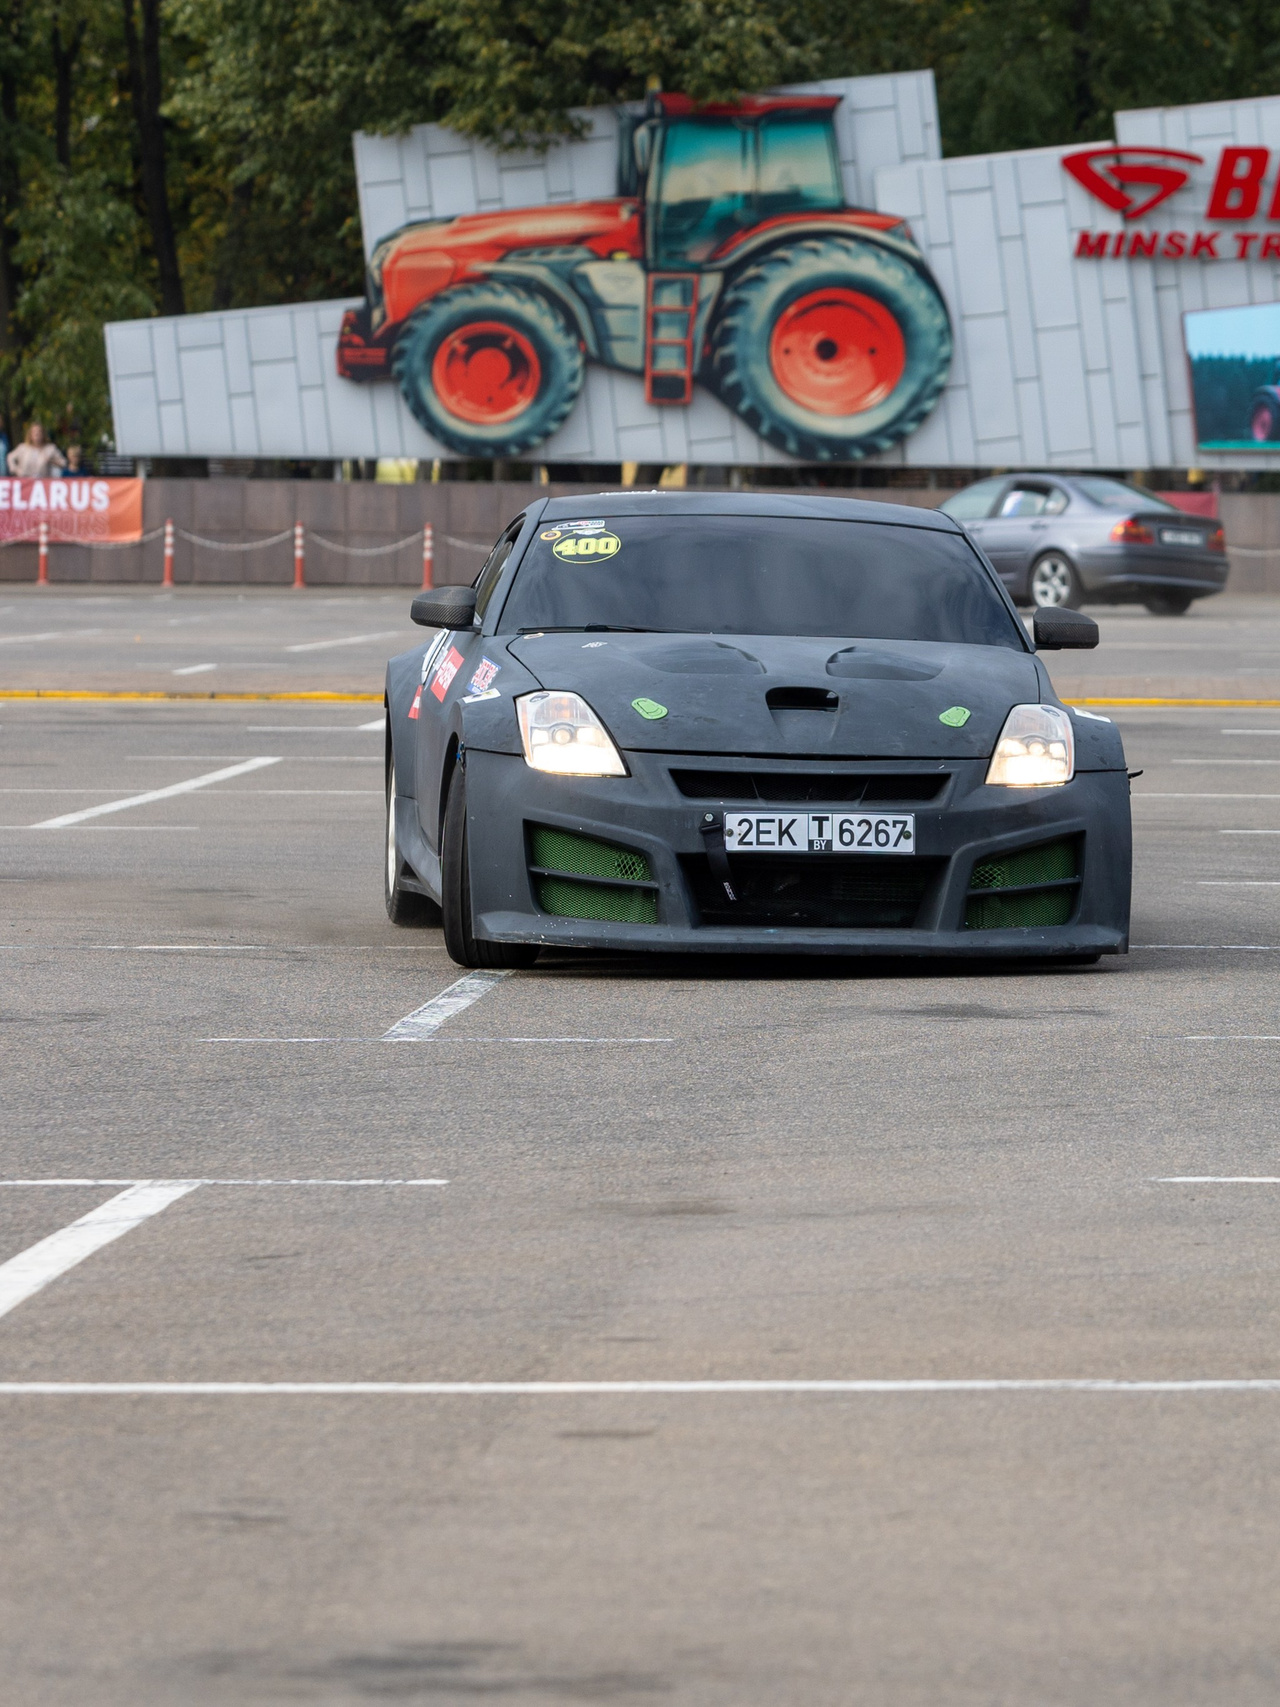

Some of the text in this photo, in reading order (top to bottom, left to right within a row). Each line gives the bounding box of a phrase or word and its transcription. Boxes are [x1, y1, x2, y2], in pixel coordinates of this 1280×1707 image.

[1075, 231, 1220, 260] MINSK
[554, 537, 618, 556] 400
[737, 816, 909, 848] 2EK T 6267
[813, 840, 828, 851] BY
